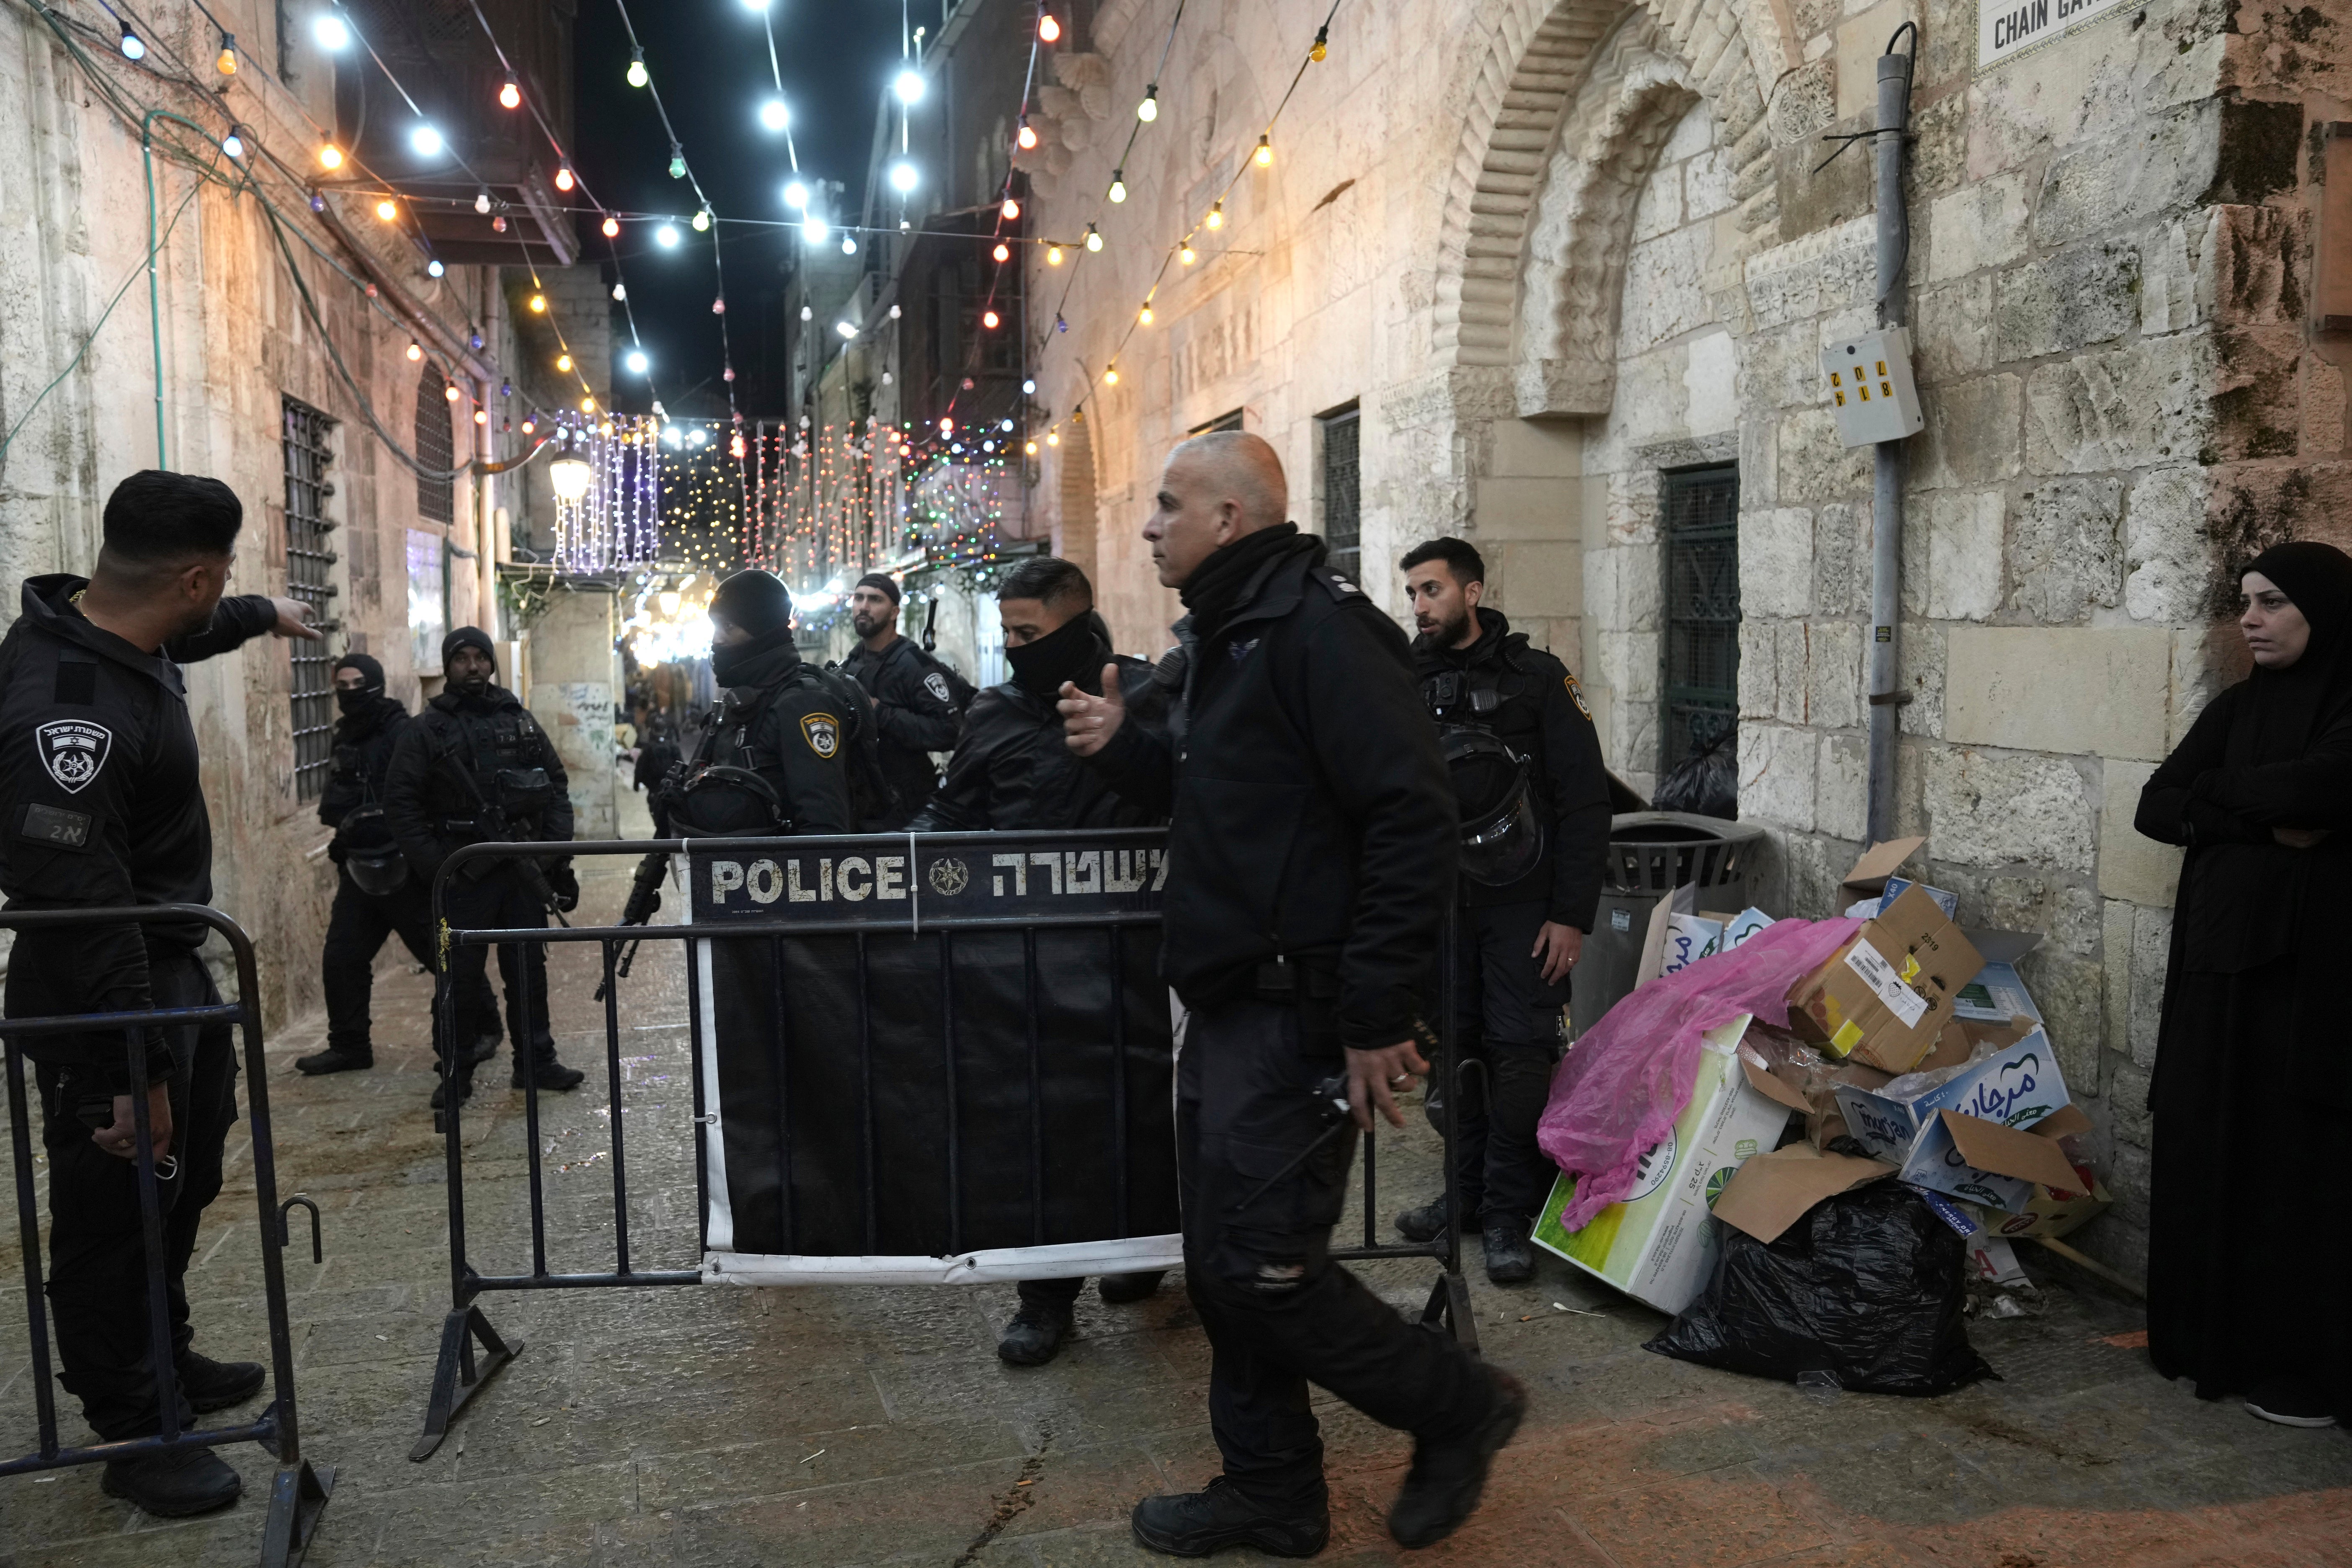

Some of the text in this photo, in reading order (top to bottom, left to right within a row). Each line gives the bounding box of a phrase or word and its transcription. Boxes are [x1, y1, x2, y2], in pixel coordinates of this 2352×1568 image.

[1995, 0, 2092, 49] CHAIN GA
[44, 725, 106, 739] משטרת ישראל
[712, 856, 906, 904] POLICE
[1888, 883, 1898, 899] X40
[1859, 1110, 1910, 1141] murjan
[2001, 1112, 2019, 1127] الحيا
[1650, 1142, 1673, 1186] 08-8594290
[1688, 1176, 1698, 1190] 25
[1939, 1203, 1962, 1224] ENERGY
